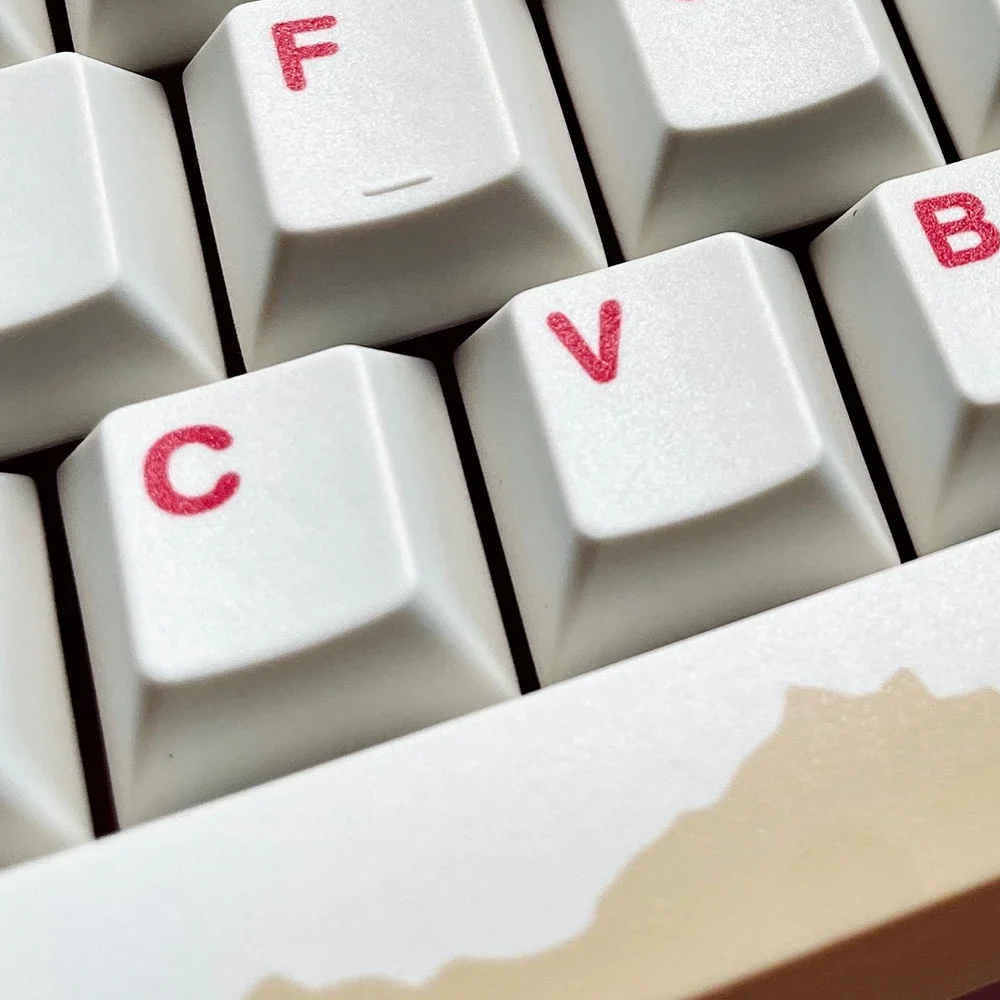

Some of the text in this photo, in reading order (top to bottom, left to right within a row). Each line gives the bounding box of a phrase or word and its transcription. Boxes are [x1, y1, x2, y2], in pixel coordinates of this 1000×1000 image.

[270, 14, 340, 93] F
[545, 298, 623, 385] V
[142, 424, 241, 517] C
